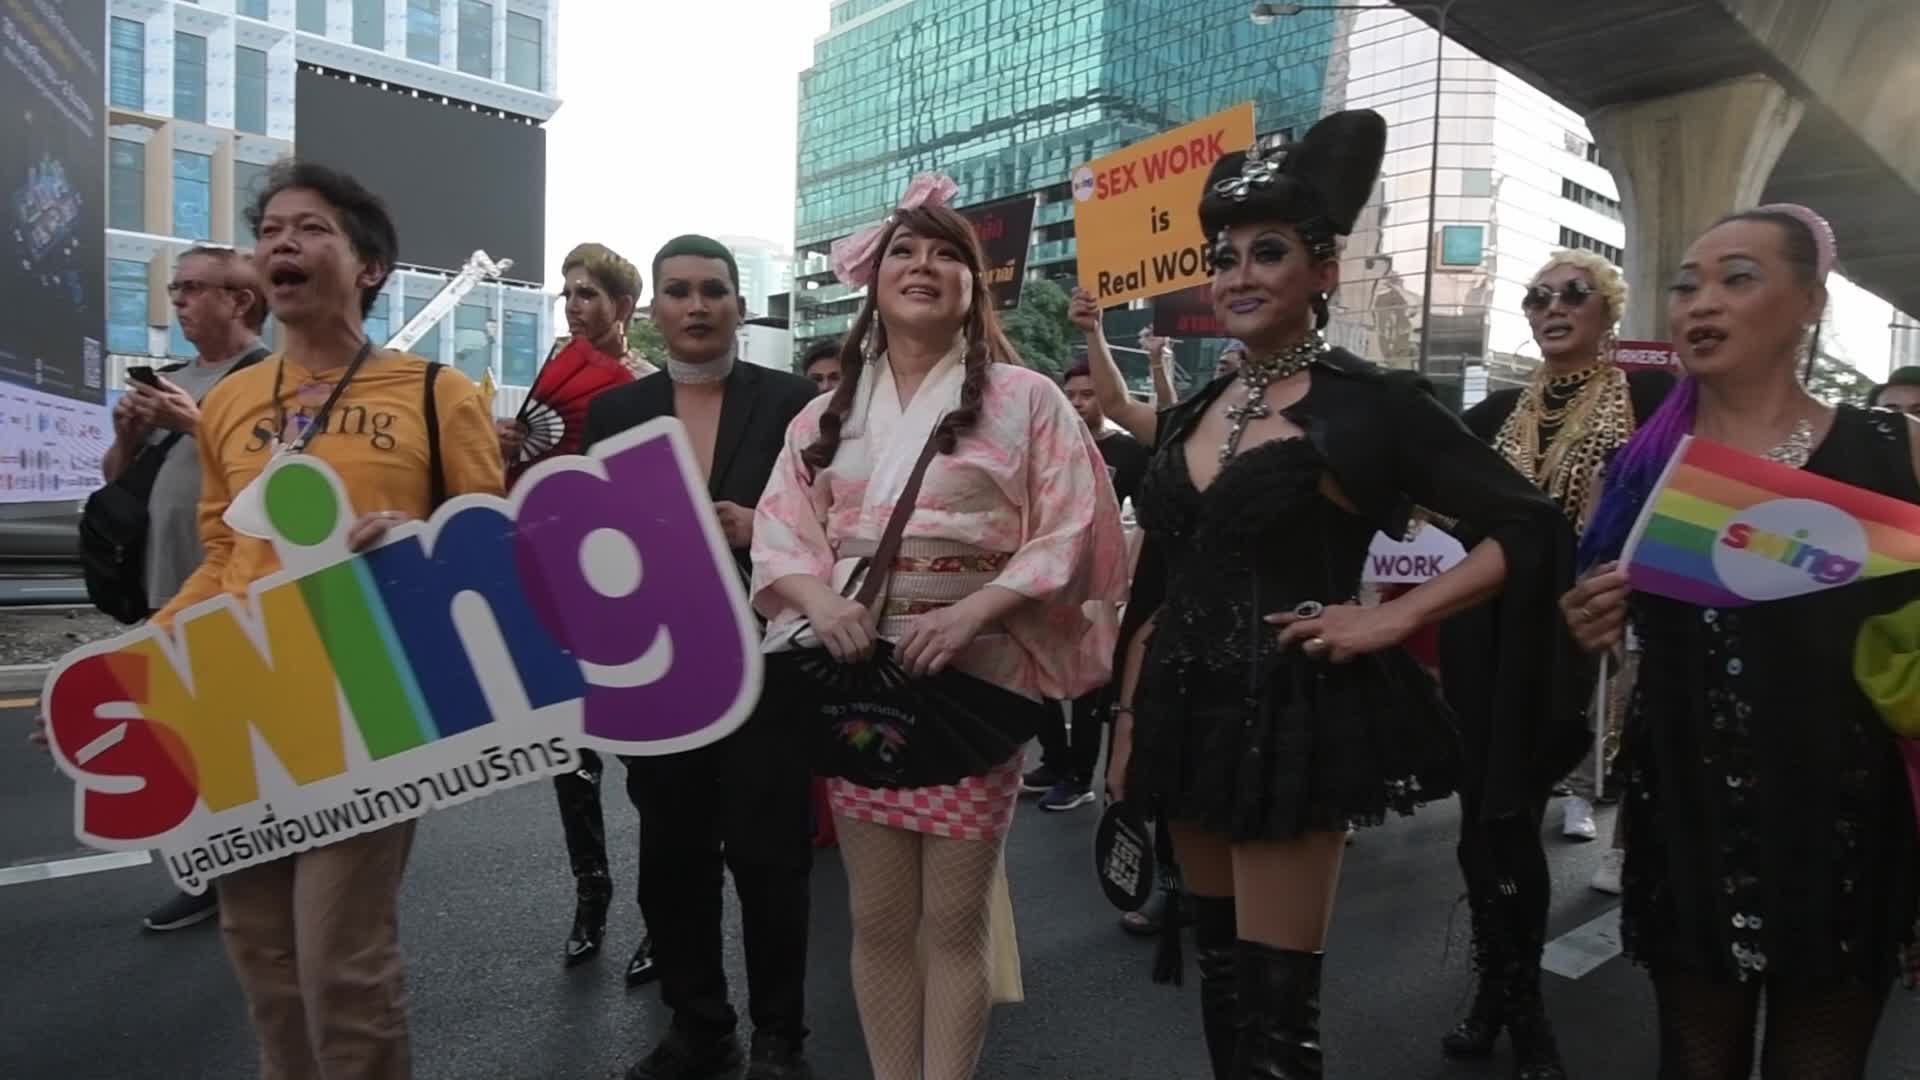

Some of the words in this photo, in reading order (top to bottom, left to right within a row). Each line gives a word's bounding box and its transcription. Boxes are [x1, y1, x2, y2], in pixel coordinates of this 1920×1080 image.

[1096, 161, 1138, 200] SEX
[1142, 129, 1225, 185] WORK
[1151, 205, 1170, 234] is
[1098, 259, 1146, 298] Real
[1152, 242, 1215, 284] WOR
[1373, 554, 1444, 577] WORK
[1719, 522, 1862, 585] swing
[48, 432, 747, 841] swing
[170, 736, 571, 887] มูลนิธิเพื่อนพนักงานบริการ
